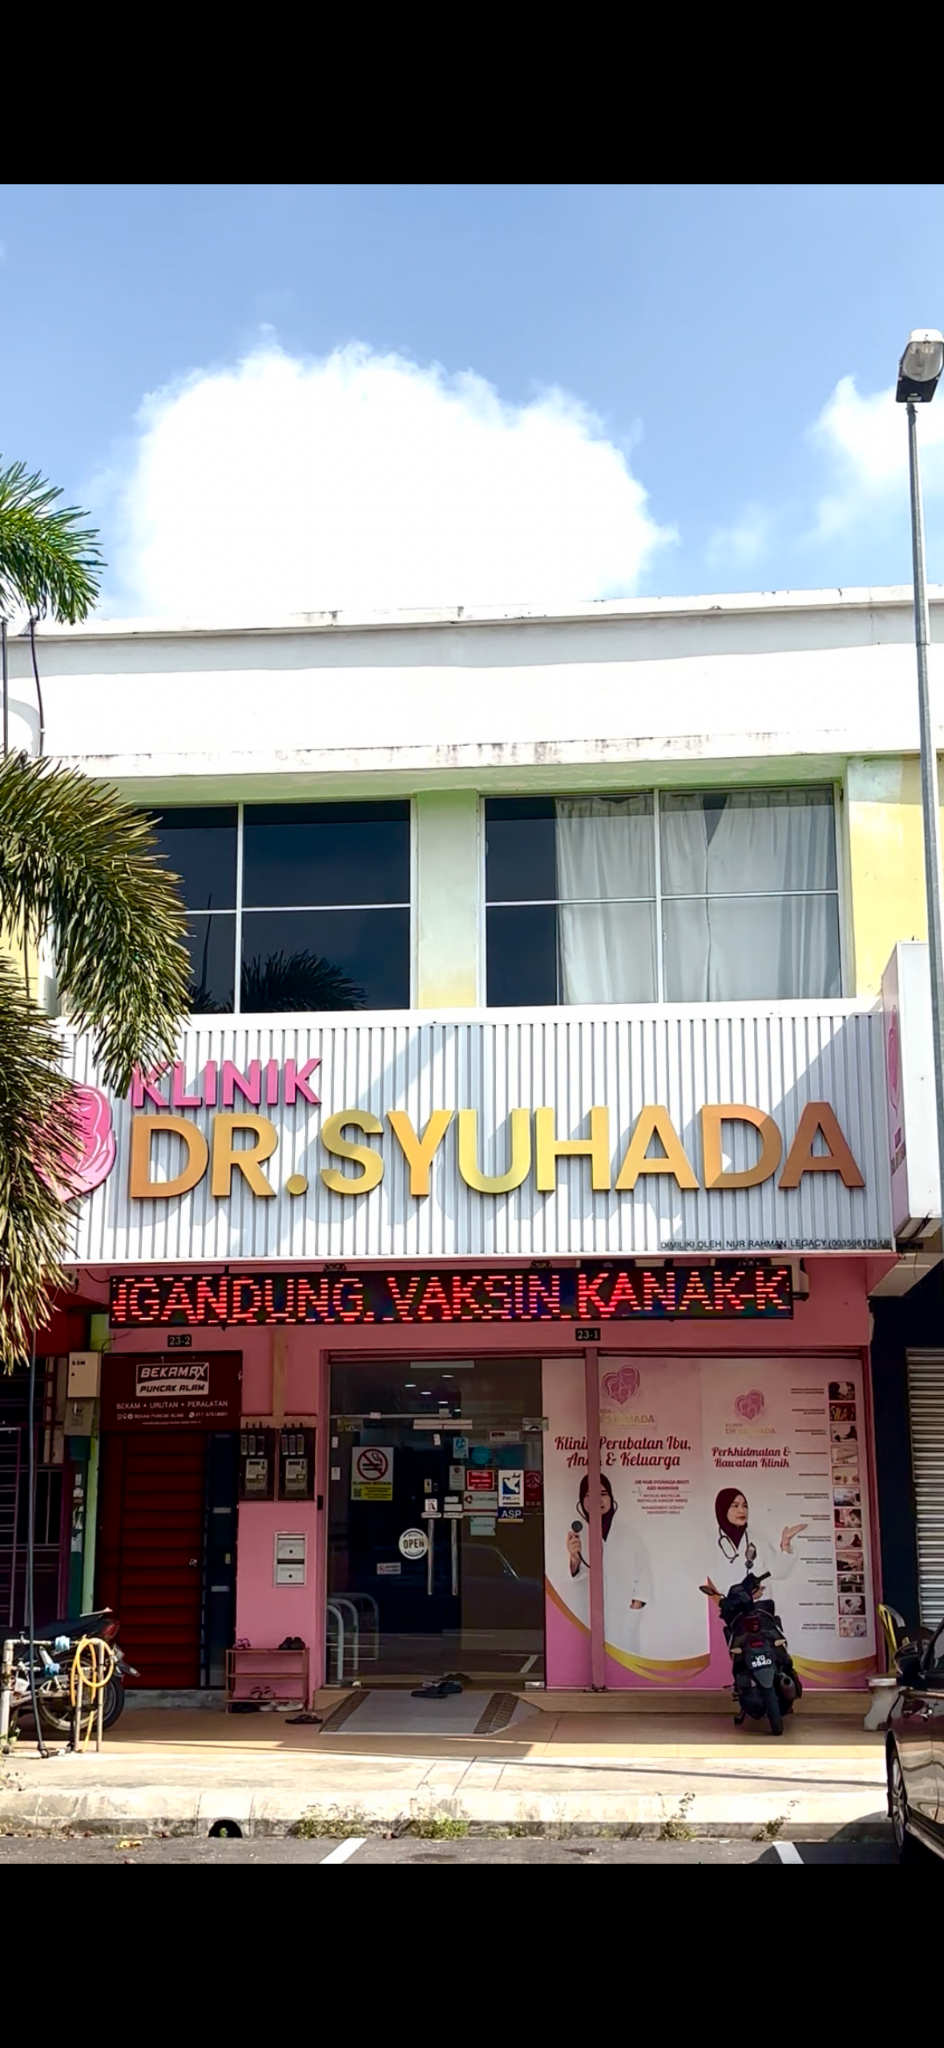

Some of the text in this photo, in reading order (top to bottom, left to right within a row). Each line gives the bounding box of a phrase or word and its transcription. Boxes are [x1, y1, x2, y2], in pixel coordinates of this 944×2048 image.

[130, 1057, 322, 1108] KLINIK
[660, 1241, 695, 1249] DIMILIKI
[726, 1240, 745, 1248] NUR
[748, 1240, 786, 1248] RAHMAN
[790, 1239, 826, 1247] LEGACY
[387, 1274, 560, 1317] VAKSIN
[577, 1271, 791, 1313] KANAK-K
[577, 1330, 598, 1339] 23-1
[169, 1336, 191, 1345] 23-2
[140, 1363, 208, 1380] BEKAMAX
[140, 1384, 205, 1393] PUNCAK ALAM
[554, 1435, 691, 1450] Klini Perubatan Ibu,
[711, 1446, 791, 1457] Perkhidmatan &
[605, 1452, 617, 1466] &
[620, 1452, 680, 1470] Keluarga
[714, 1457, 790, 1468] Rawatan Klinik
[501, 1510, 522, 1518] ASP
[403, 1539, 424, 1549] OPEN
